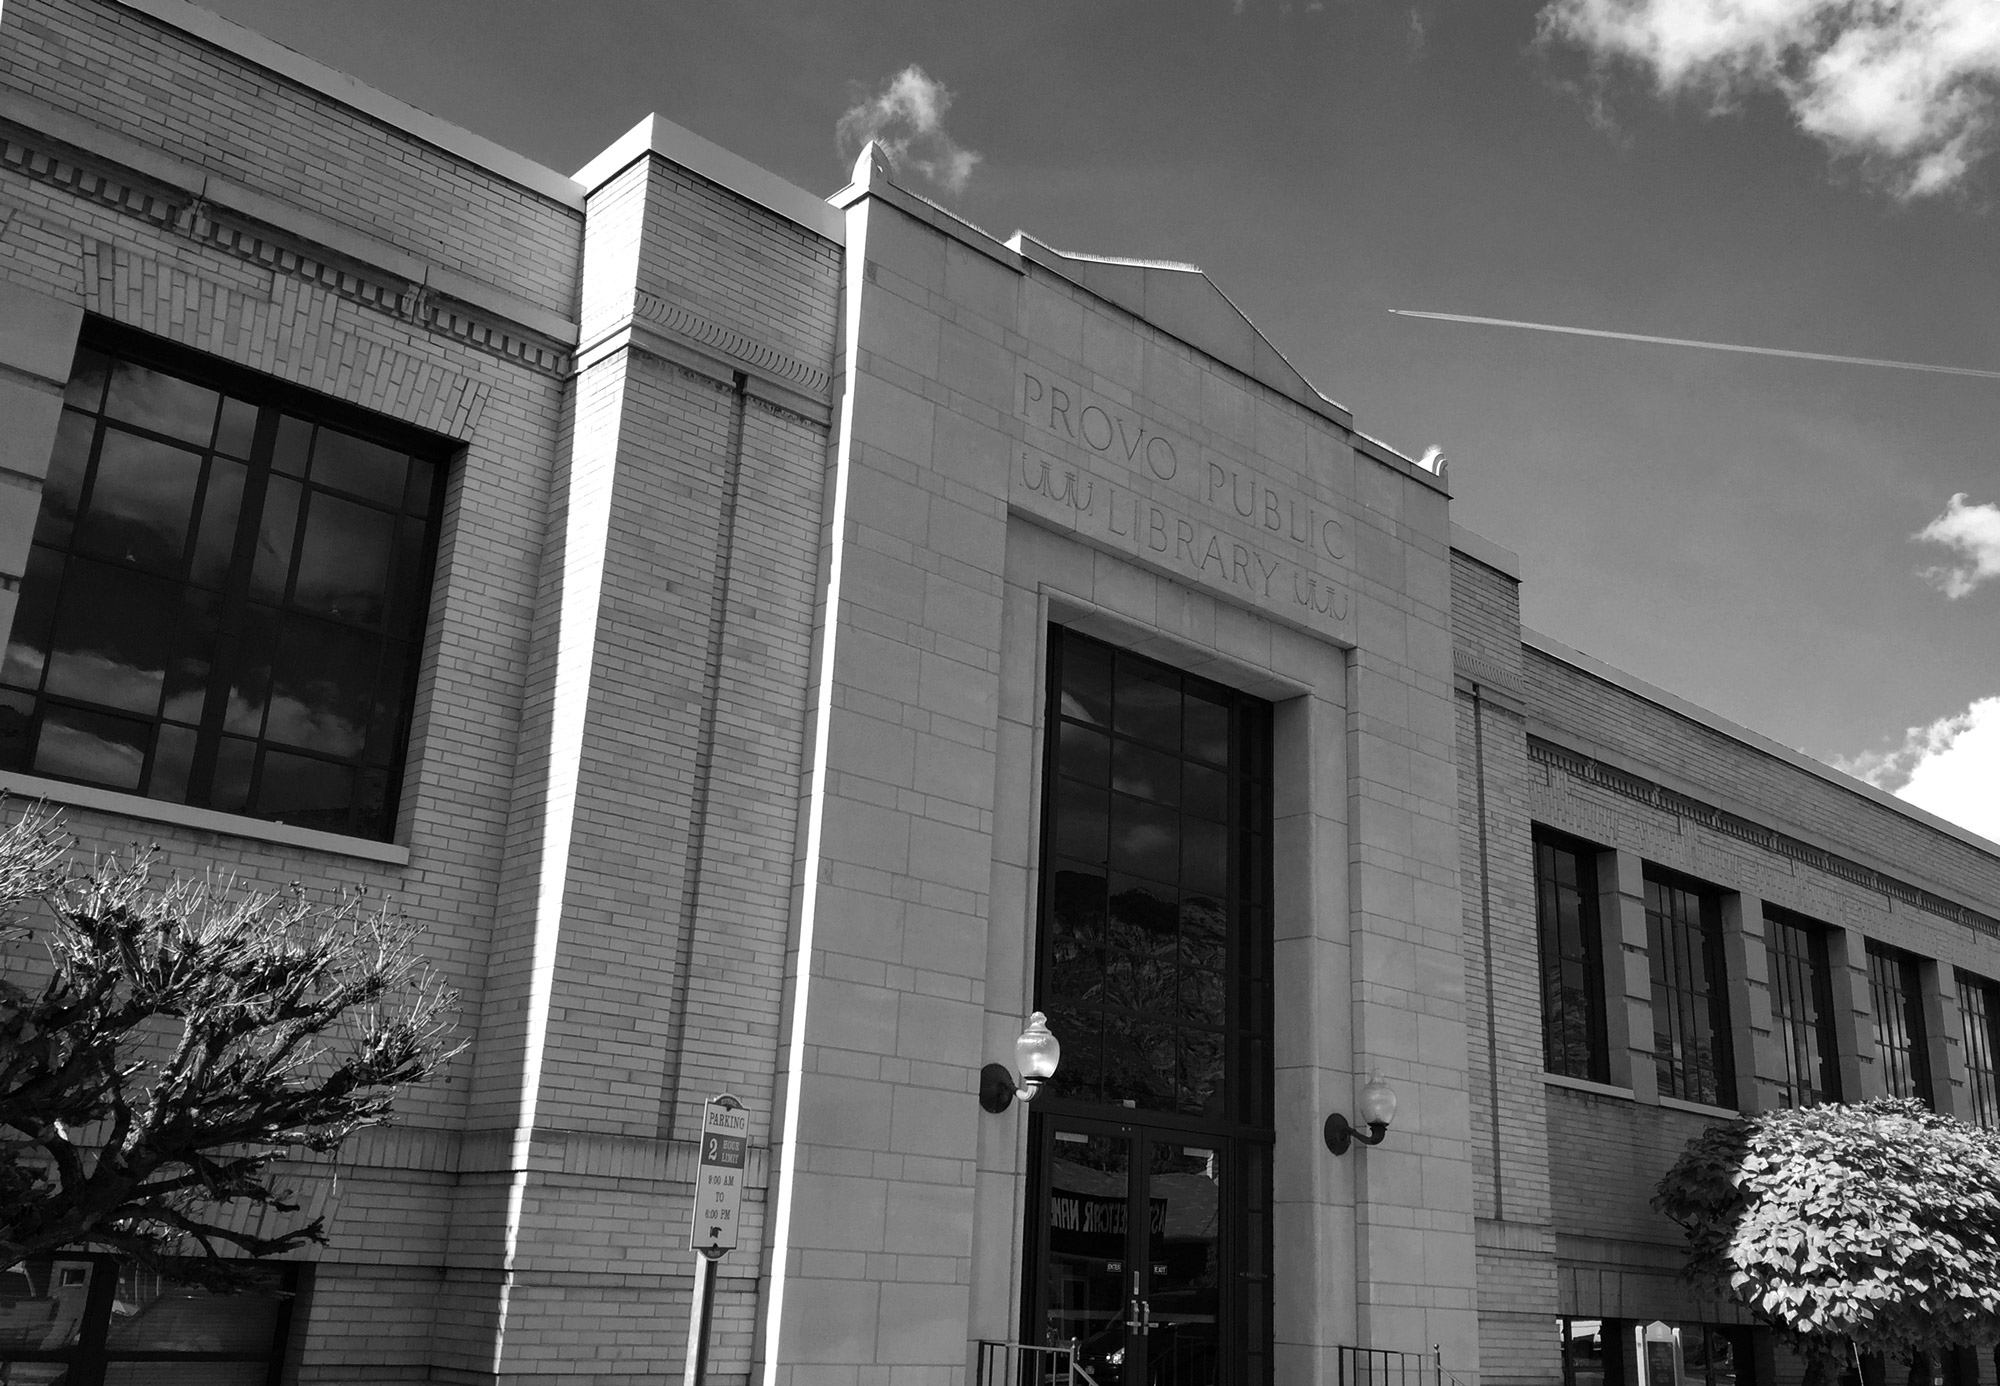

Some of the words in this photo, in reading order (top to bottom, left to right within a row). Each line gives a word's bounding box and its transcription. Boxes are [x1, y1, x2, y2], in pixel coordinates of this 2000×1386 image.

[1021, 372, 1178, 481] PROVO
[1207, 460, 1347, 560] PUBLIC
[1107, 488, 1281, 598] LIBRARY
[708, 1112, 745, 1130] PARKING
[708, 1138, 718, 1161] 2
[722, 1139, 740, 1151] HOUR
[721, 1152, 740, 1164] LIMIT
[723, 1176, 734, 1186] AM
[715, 1192, 724, 1203] TO
[720, 1209, 731, 1220] PM
